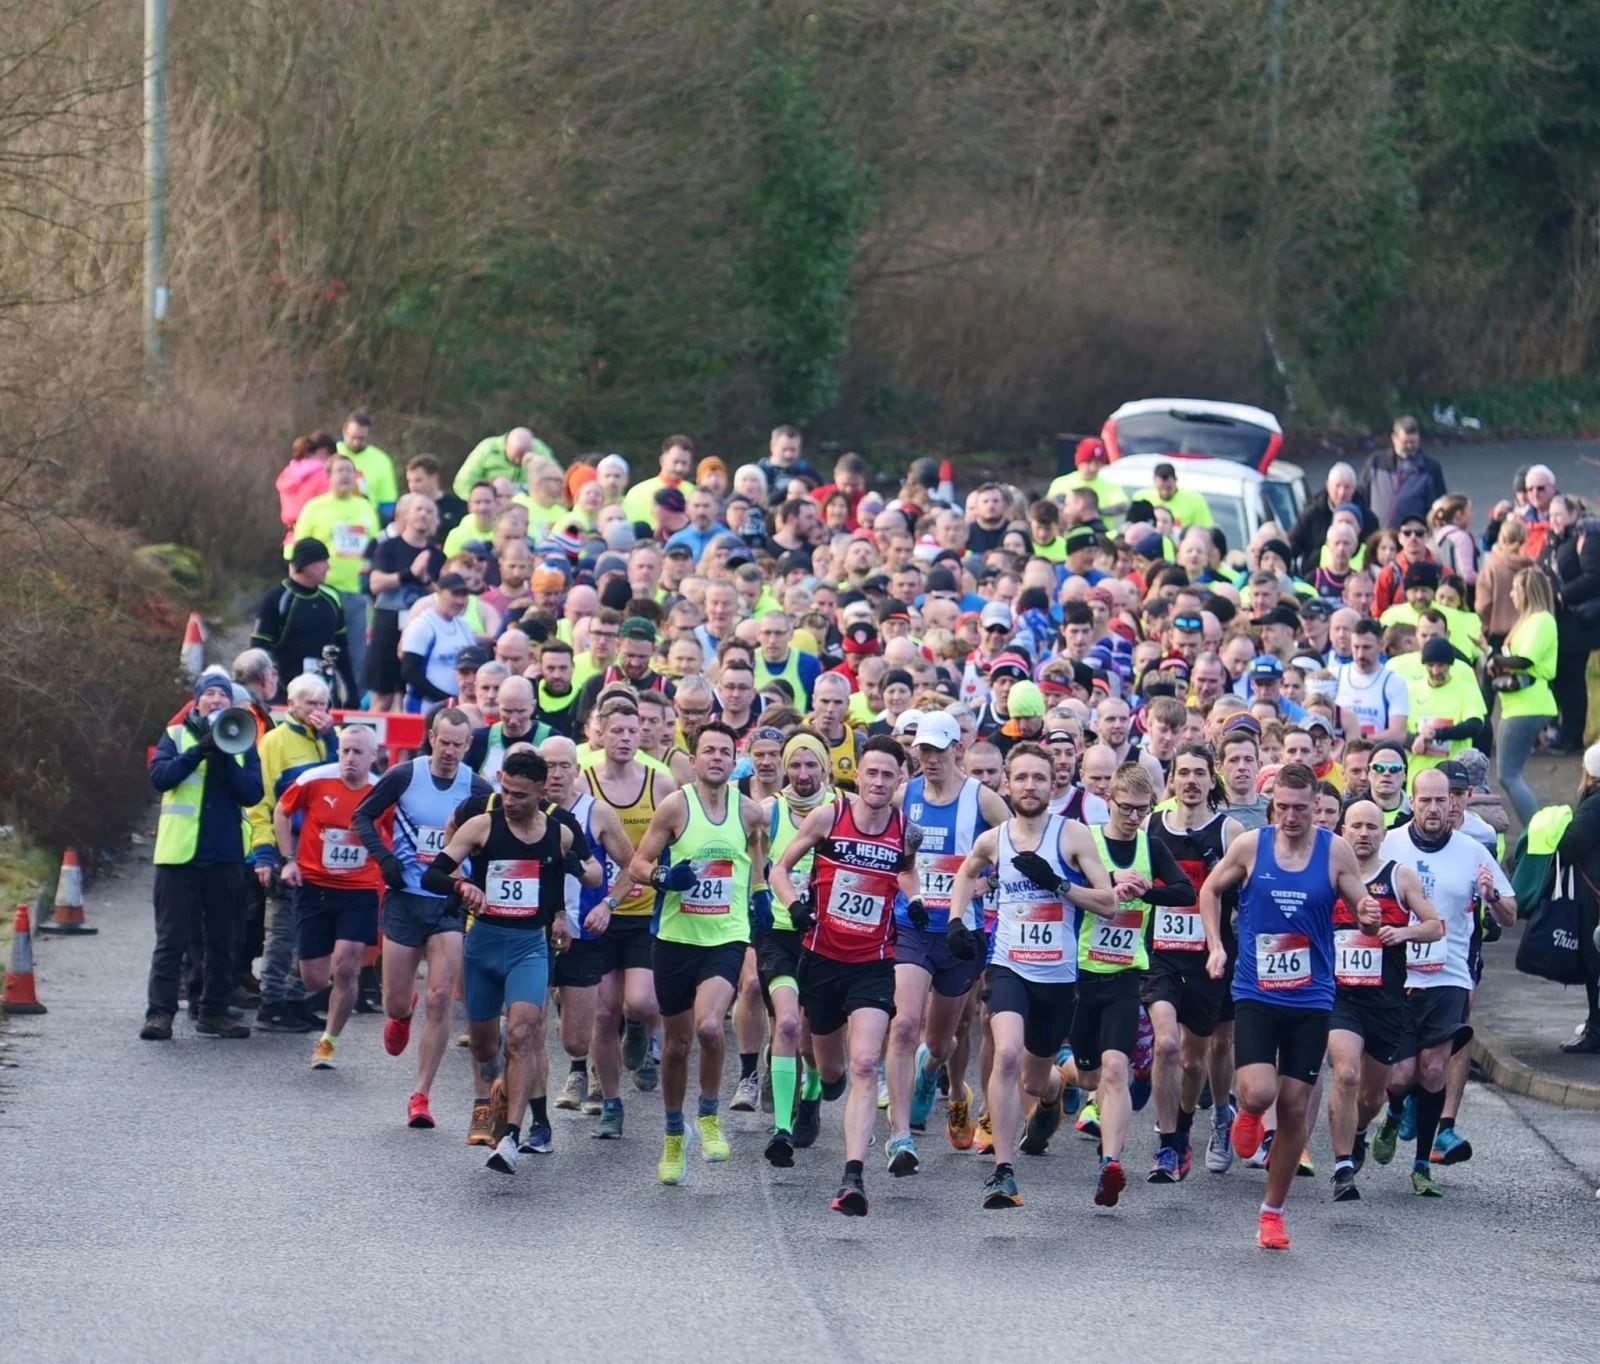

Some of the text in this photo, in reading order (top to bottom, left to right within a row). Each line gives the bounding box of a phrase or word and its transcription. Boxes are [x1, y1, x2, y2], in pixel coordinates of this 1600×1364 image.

[330, 846, 359, 863] 444
[833, 841, 898, 863] ST. HELENS
[840, 853, 891, 870] Striders
[500, 880, 523, 900] 58
[690, 880, 723, 899] 284
[925, 873, 954, 892] 147
[838, 892, 875, 916] 230
[1271, 890, 1308, 899] CHESTER
[1020, 923, 1053, 944] 146
[1162, 914, 1194, 935] 331
[1098, 927, 1134, 949] 262
[1013, 951, 1060, 960] TheVellaGroup
[1341, 950, 1373, 969] 140
[1412, 942, 1432, 960] 97
[1265, 952, 1301, 974] 246
